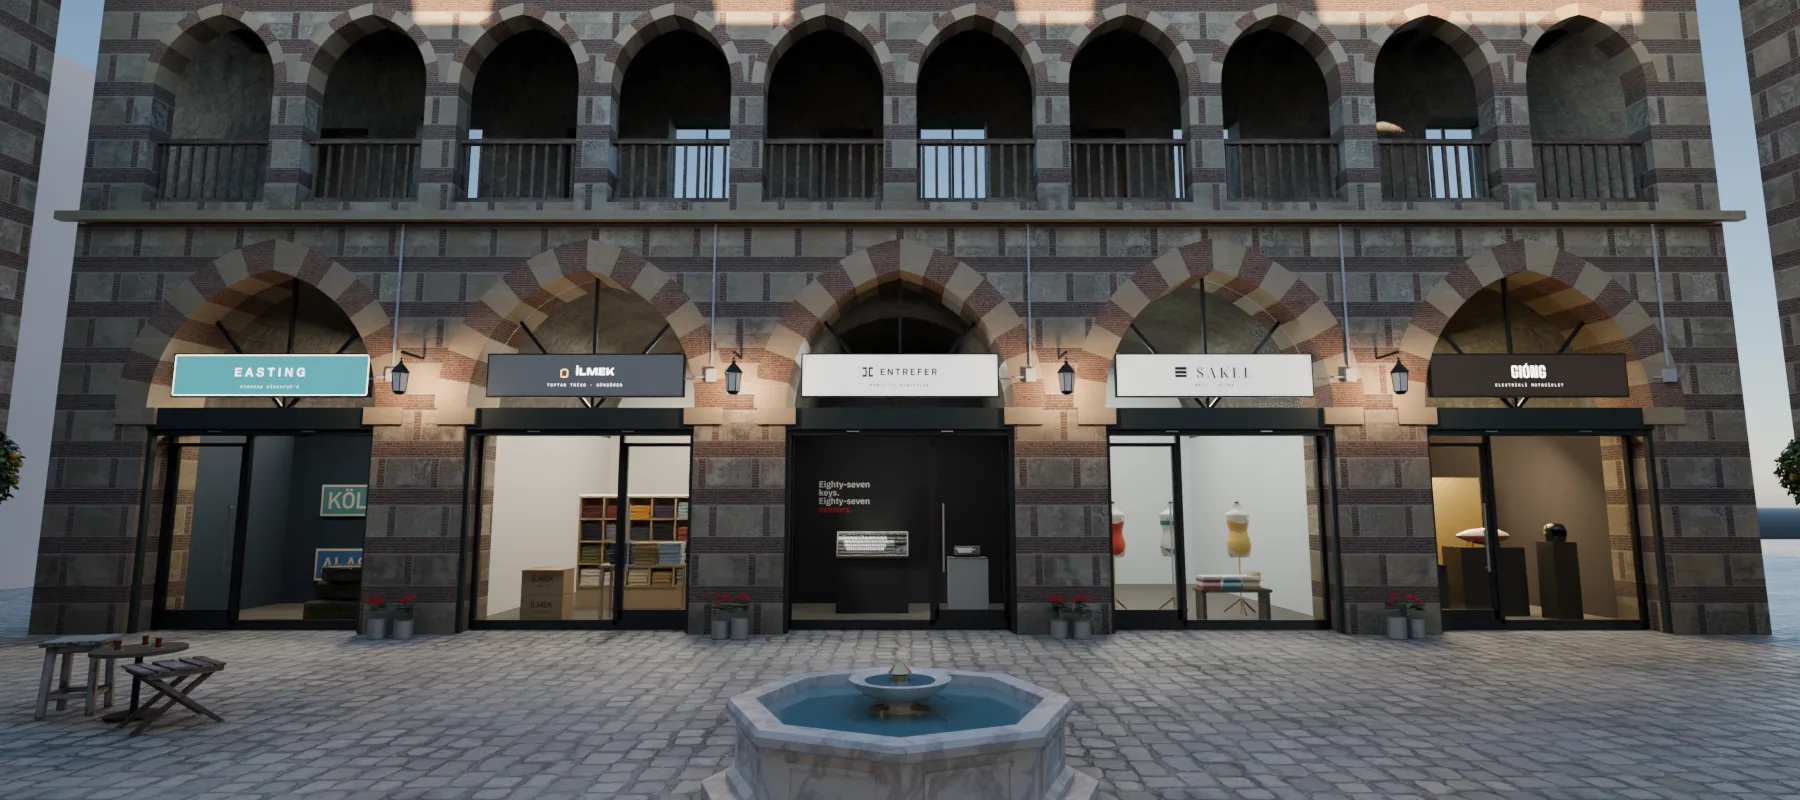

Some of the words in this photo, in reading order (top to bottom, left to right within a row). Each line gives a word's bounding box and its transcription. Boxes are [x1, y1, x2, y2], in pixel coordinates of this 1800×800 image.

[234, 367, 306, 378] EASTING
[575, 364, 615, 377] İLMEK
[880, 368, 937, 376] ENTREFER
[1196, 367, 1253, 378] SAKEL
[1510, 362, 1547, 379] GIÓNG
[818, 480, 871, 489] Eighty-seven
[818, 489, 840, 498] keys.
[818, 497, 871, 506] Eighty-seven
